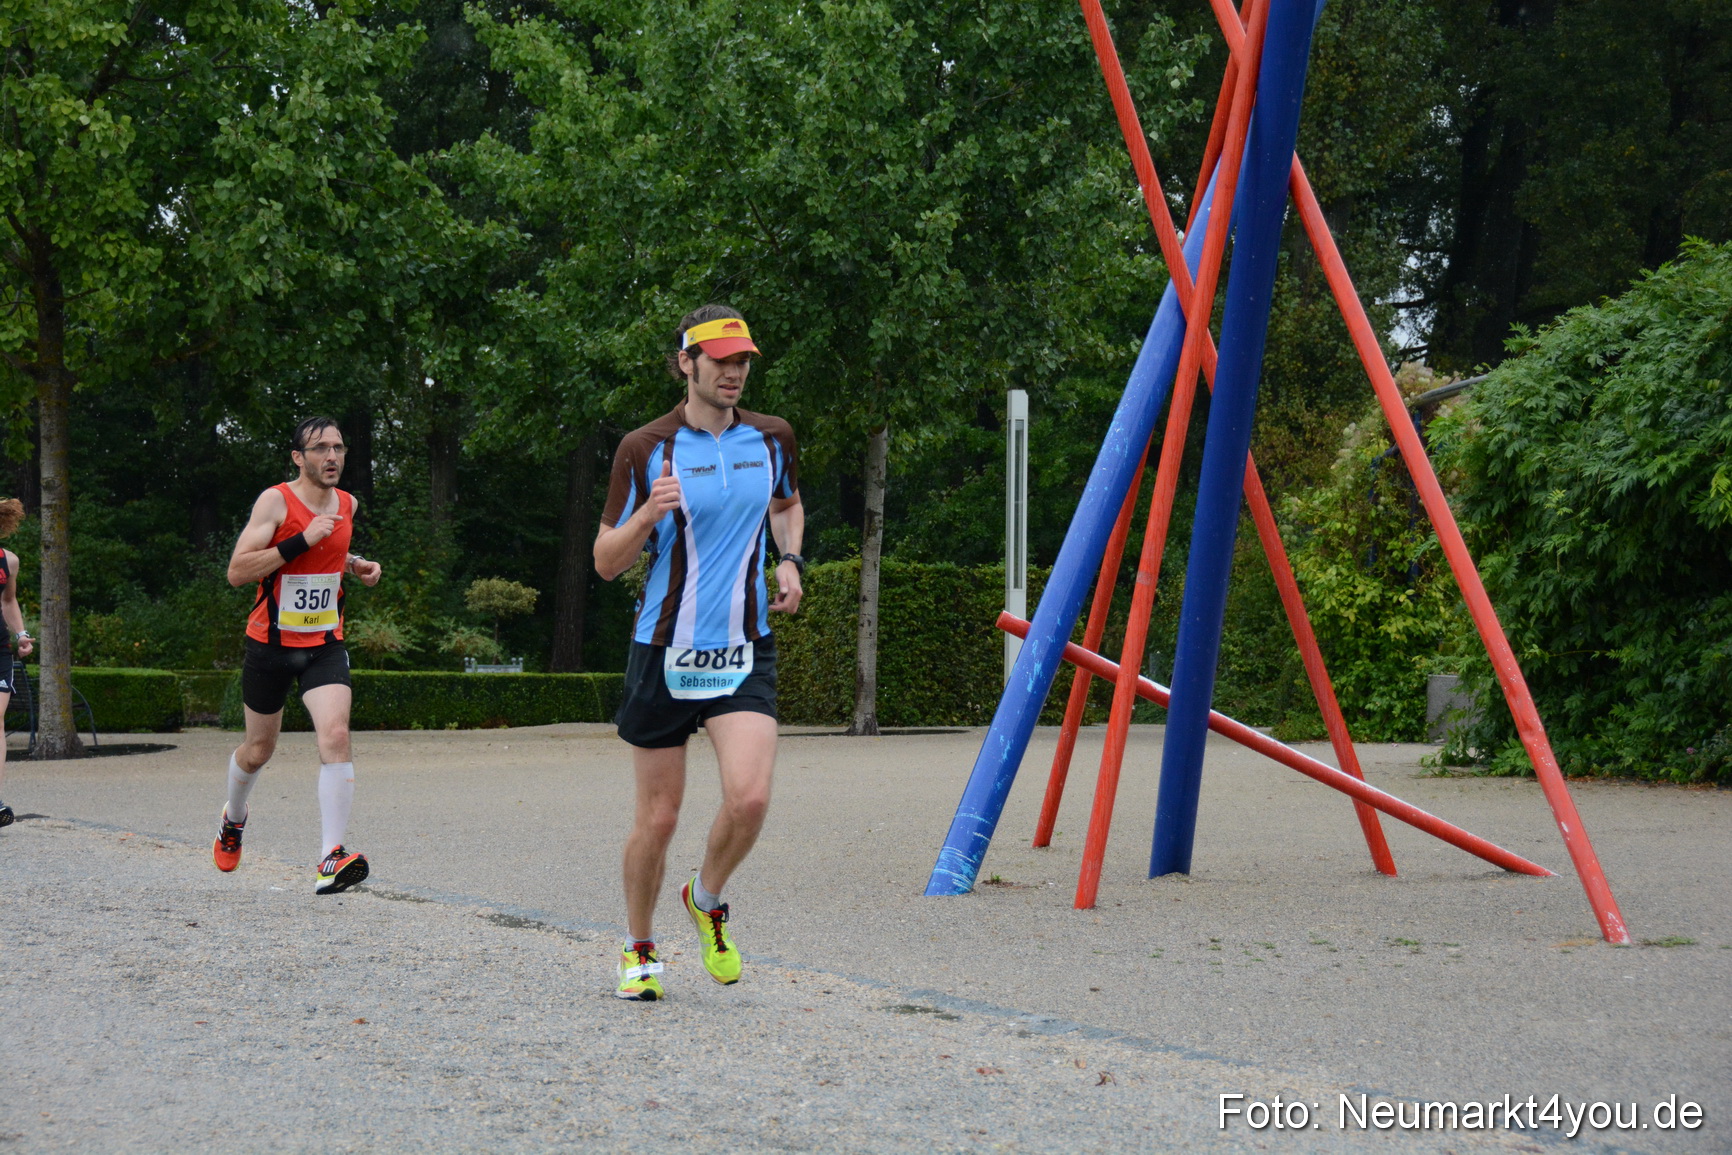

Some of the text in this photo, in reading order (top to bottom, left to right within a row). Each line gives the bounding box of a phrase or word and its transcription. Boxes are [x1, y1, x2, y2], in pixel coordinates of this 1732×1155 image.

[294, 588, 331, 610] 350
[303, 615, 320, 625] Karl
[675, 644, 745, 670] 2684
[680, 675, 734, 688] Sebastian
